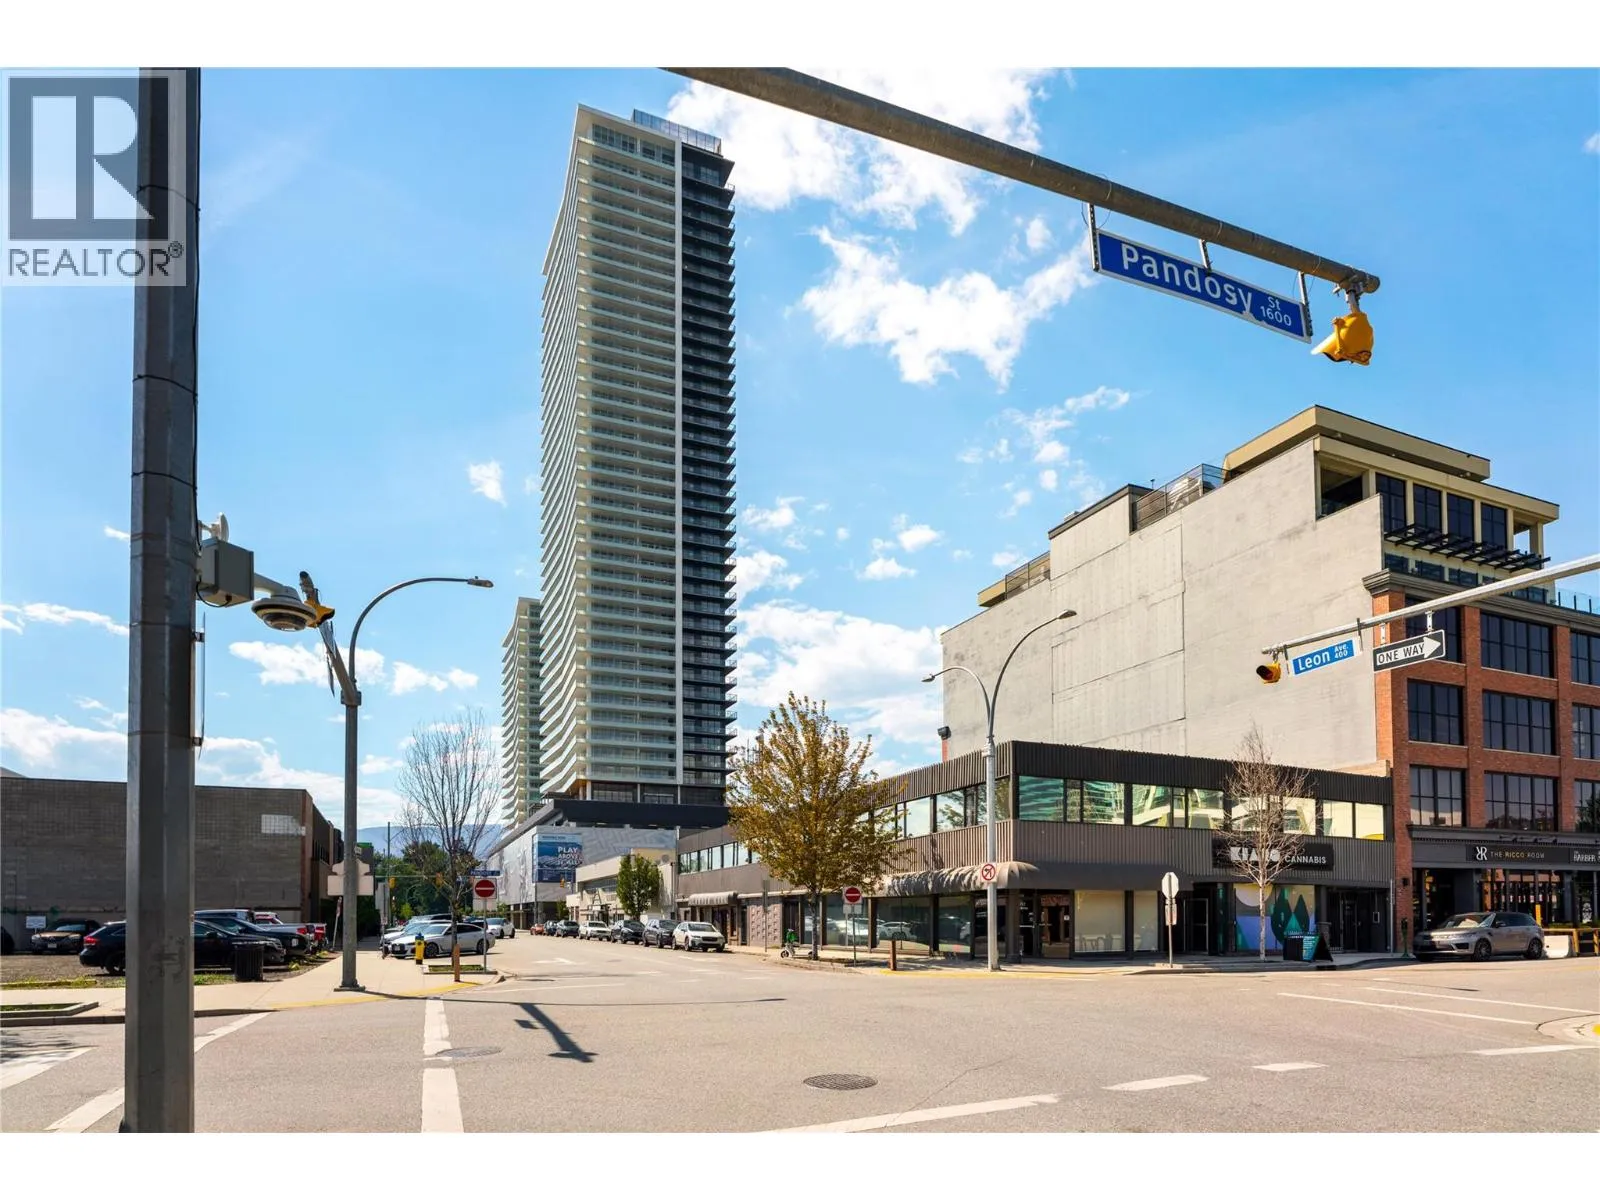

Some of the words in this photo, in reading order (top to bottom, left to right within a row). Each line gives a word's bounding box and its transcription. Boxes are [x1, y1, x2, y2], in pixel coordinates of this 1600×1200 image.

[1121, 243, 1252, 314] Pandosy
[1268, 296, 1281, 311] St
[1260, 305, 1292, 327] 1600
[1298, 650, 1330, 671] Leon
[1334, 649, 1348, 659] 400
[1378, 651, 1399, 664] ONE
[1403, 643, 1425, 657] WAY
[1284, 855, 1327, 864] CANNABIS
[1573, 854, 1596, 862] BARBER
